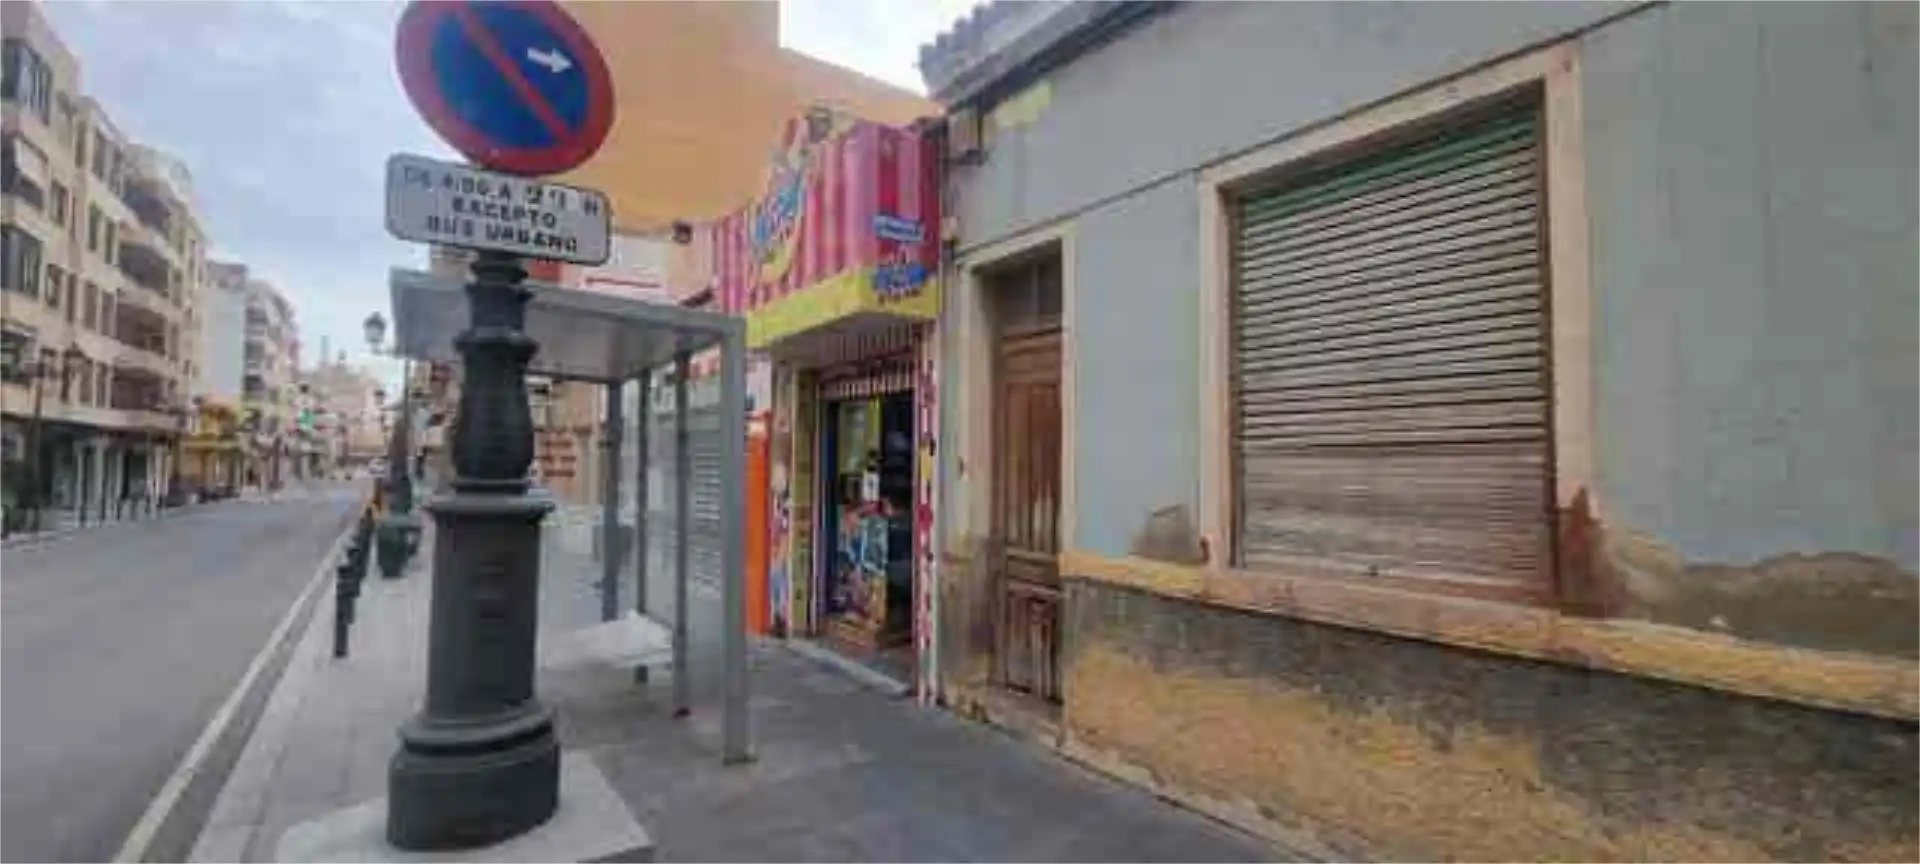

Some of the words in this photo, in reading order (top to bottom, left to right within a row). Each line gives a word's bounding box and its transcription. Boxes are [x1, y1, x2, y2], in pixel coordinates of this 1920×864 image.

[500, 182, 512, 199] A
[453, 197, 557, 228] EXCEPTO
[486, 224, 577, 251] URBANO
